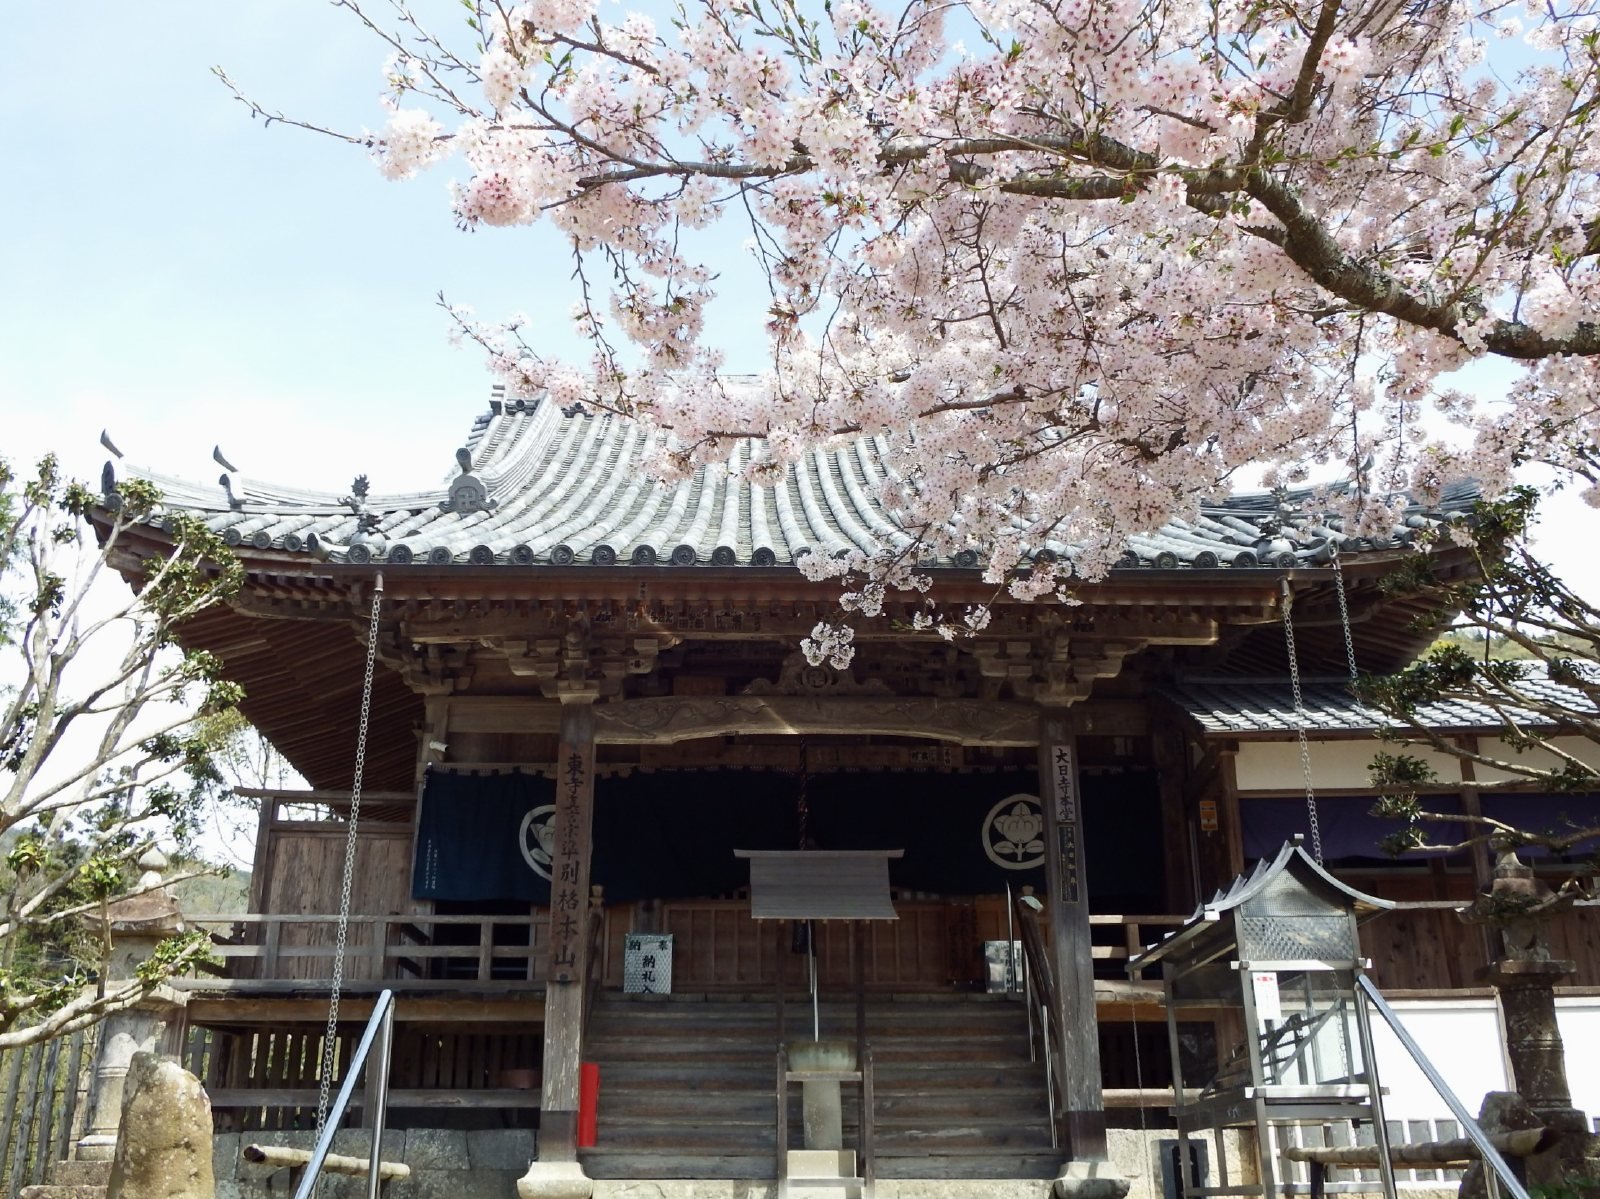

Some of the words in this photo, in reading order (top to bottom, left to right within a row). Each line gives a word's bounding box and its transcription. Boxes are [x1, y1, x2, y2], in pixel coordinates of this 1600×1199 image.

[1055, 747, 1074, 822] 大日寺本堂
[641, 954, 656, 994] 納札入
